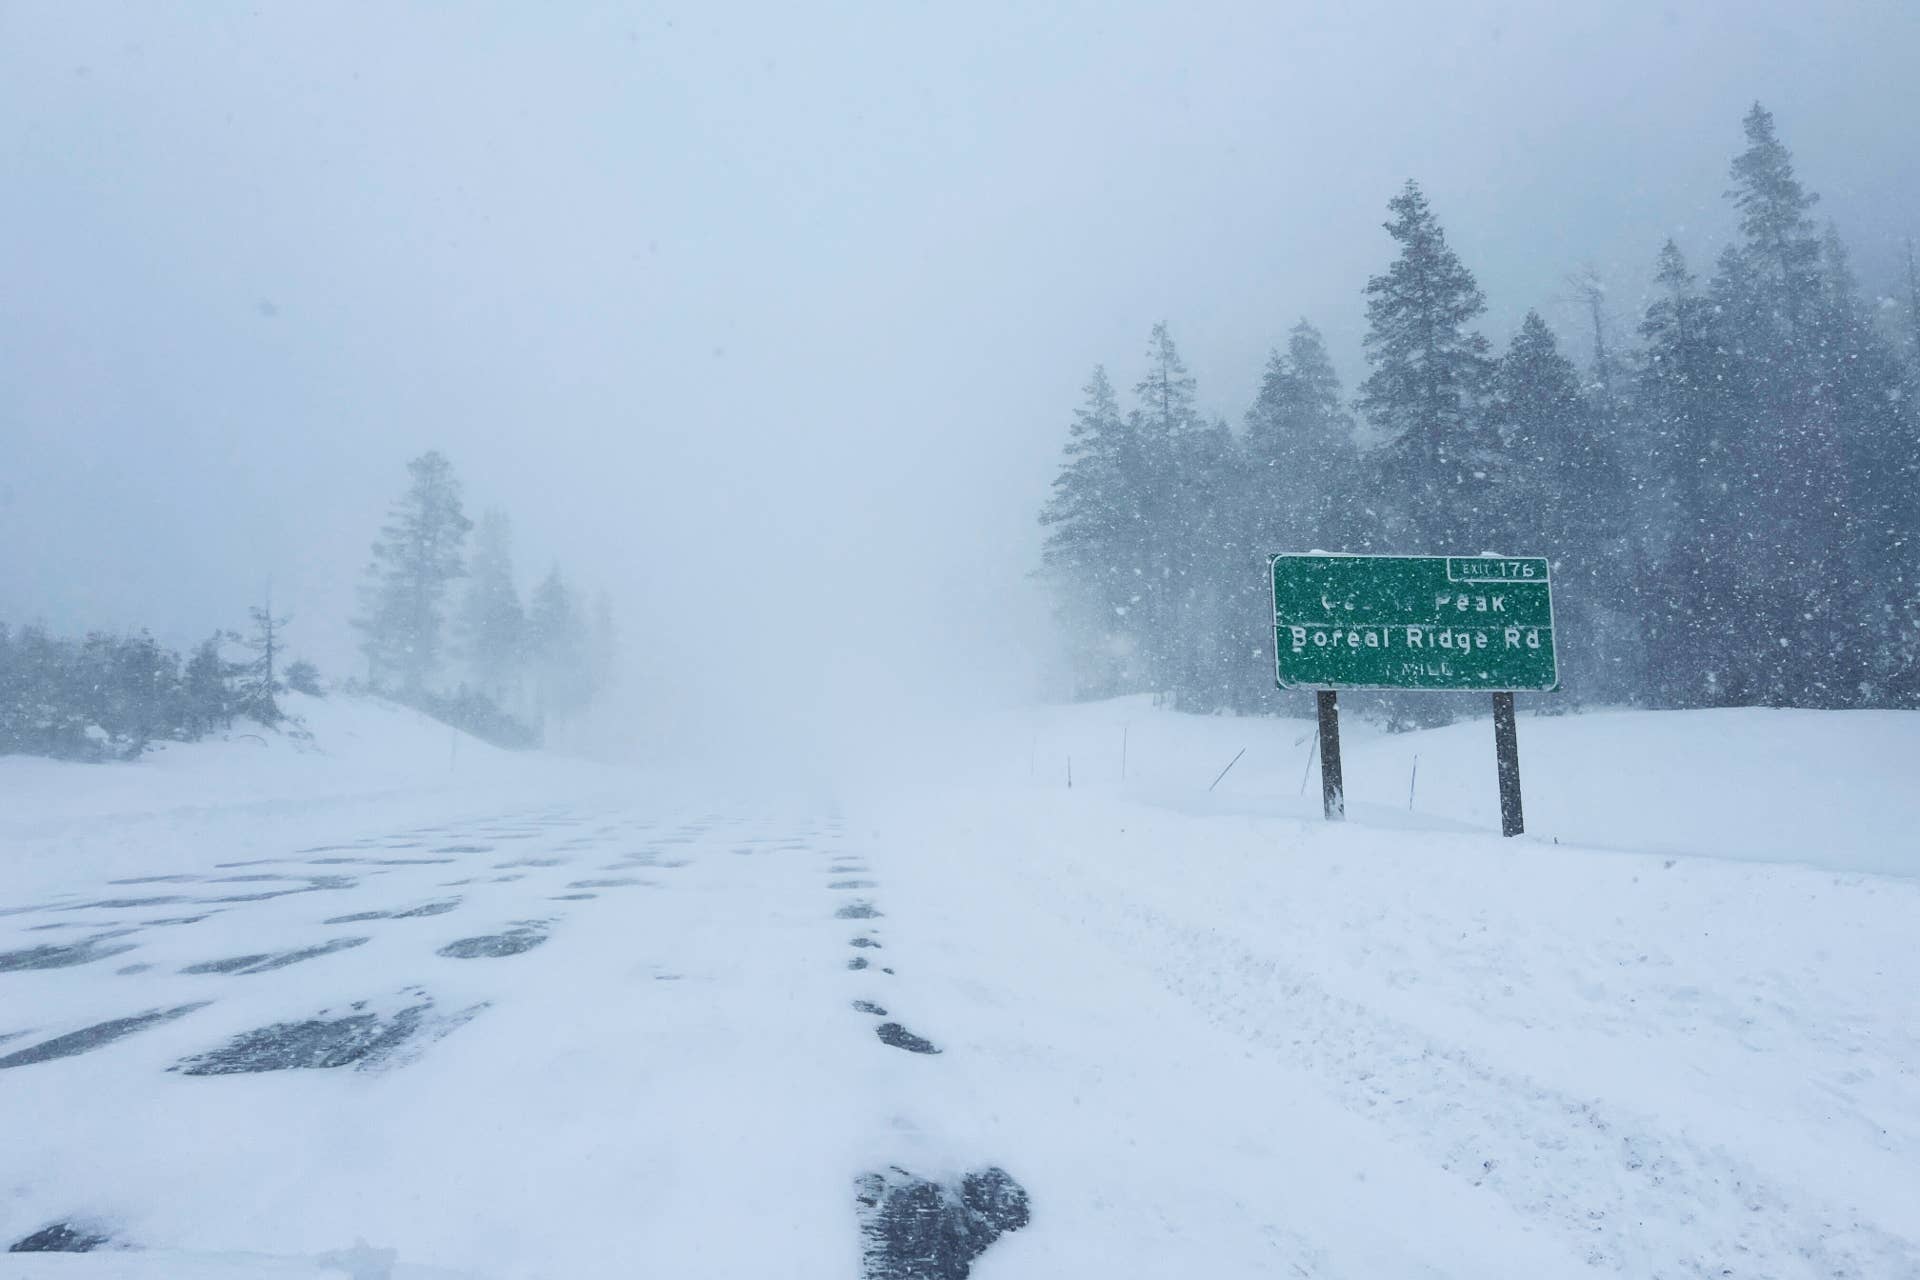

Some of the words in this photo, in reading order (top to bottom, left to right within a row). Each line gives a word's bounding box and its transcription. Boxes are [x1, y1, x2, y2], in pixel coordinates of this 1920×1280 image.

[1463, 563, 1489, 574] EXIT
[1500, 562, 1534, 577] 176
[1434, 592, 1506, 612] Peak
[1291, 626, 1389, 649] Boreal
[1407, 627, 1488, 655] Ridge
[1504, 628, 1541, 649] Rd
